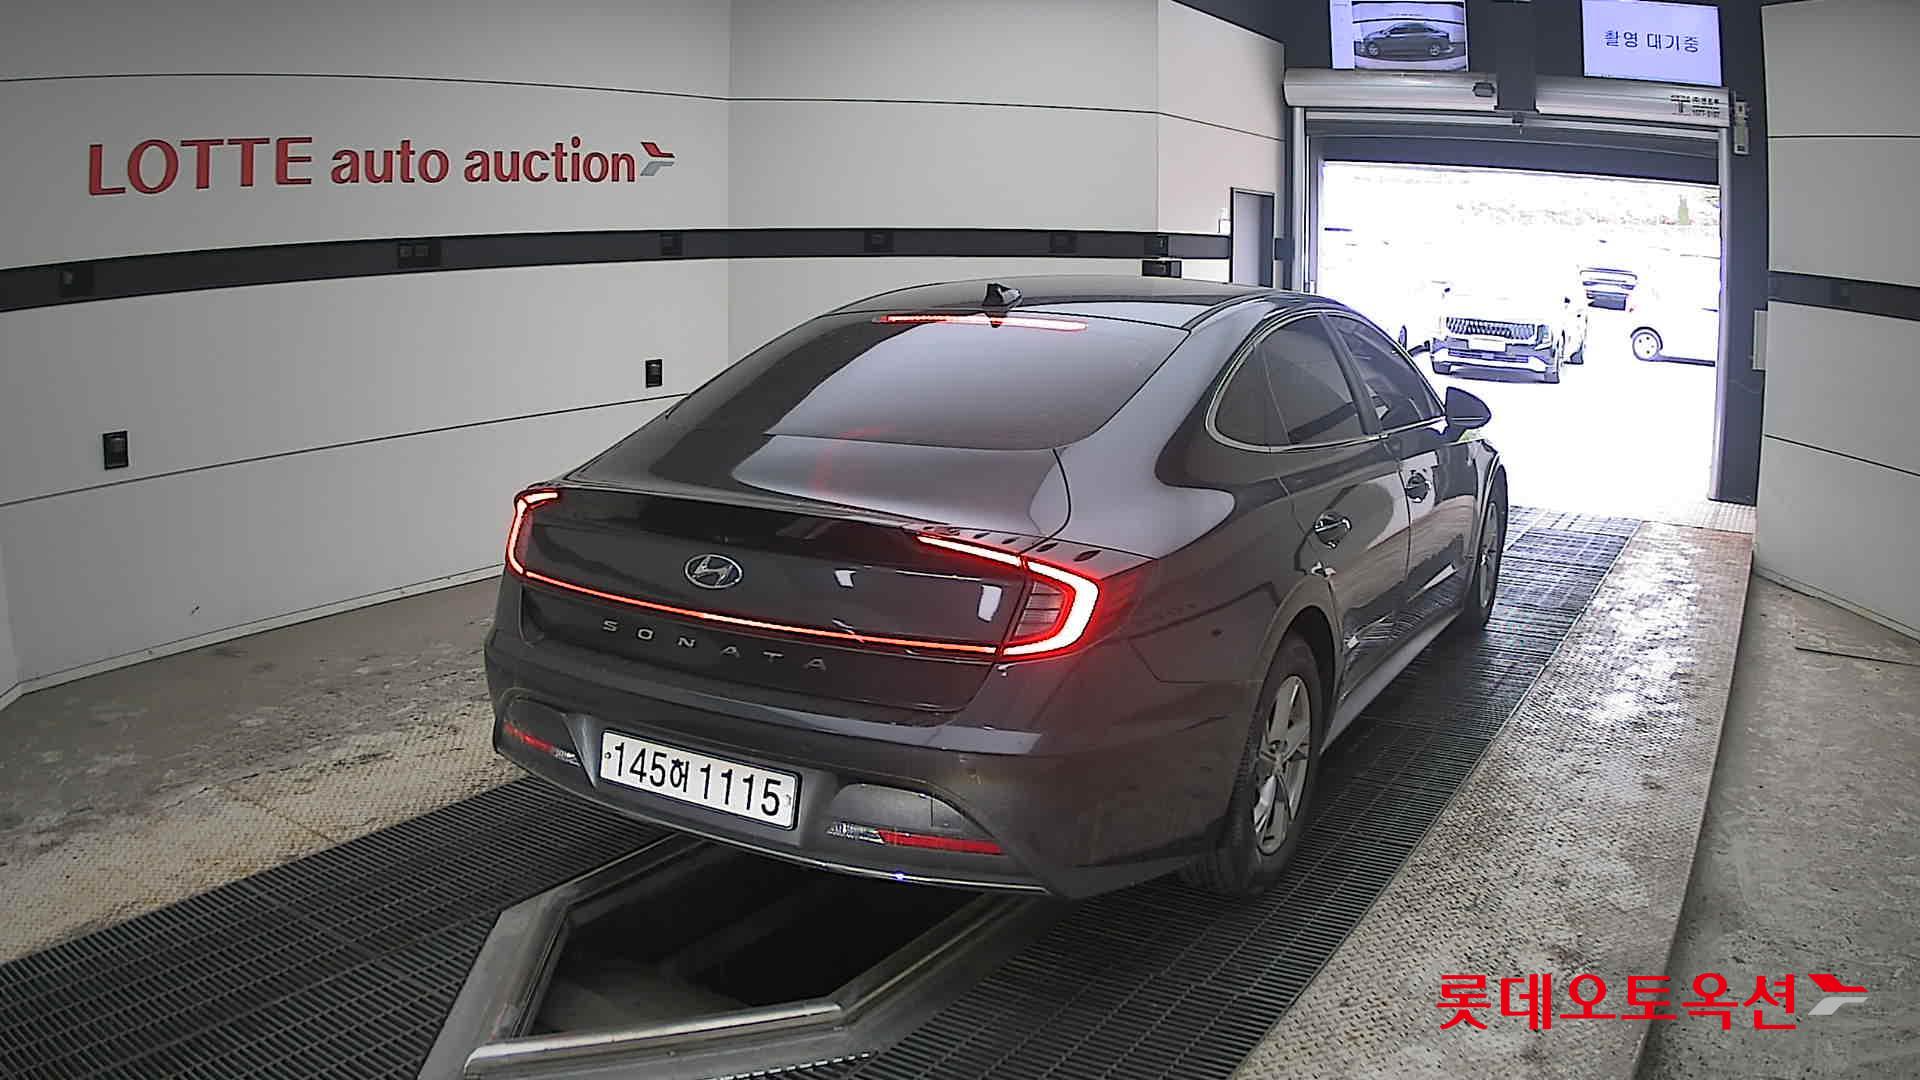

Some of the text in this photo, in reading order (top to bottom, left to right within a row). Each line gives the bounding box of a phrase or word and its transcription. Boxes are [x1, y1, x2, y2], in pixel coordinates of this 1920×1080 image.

[1646, 33, 1699, 53] 대기중
[88, 136, 637, 196] LOTTE auto auction
[602, 619, 827, 672] SONATA
